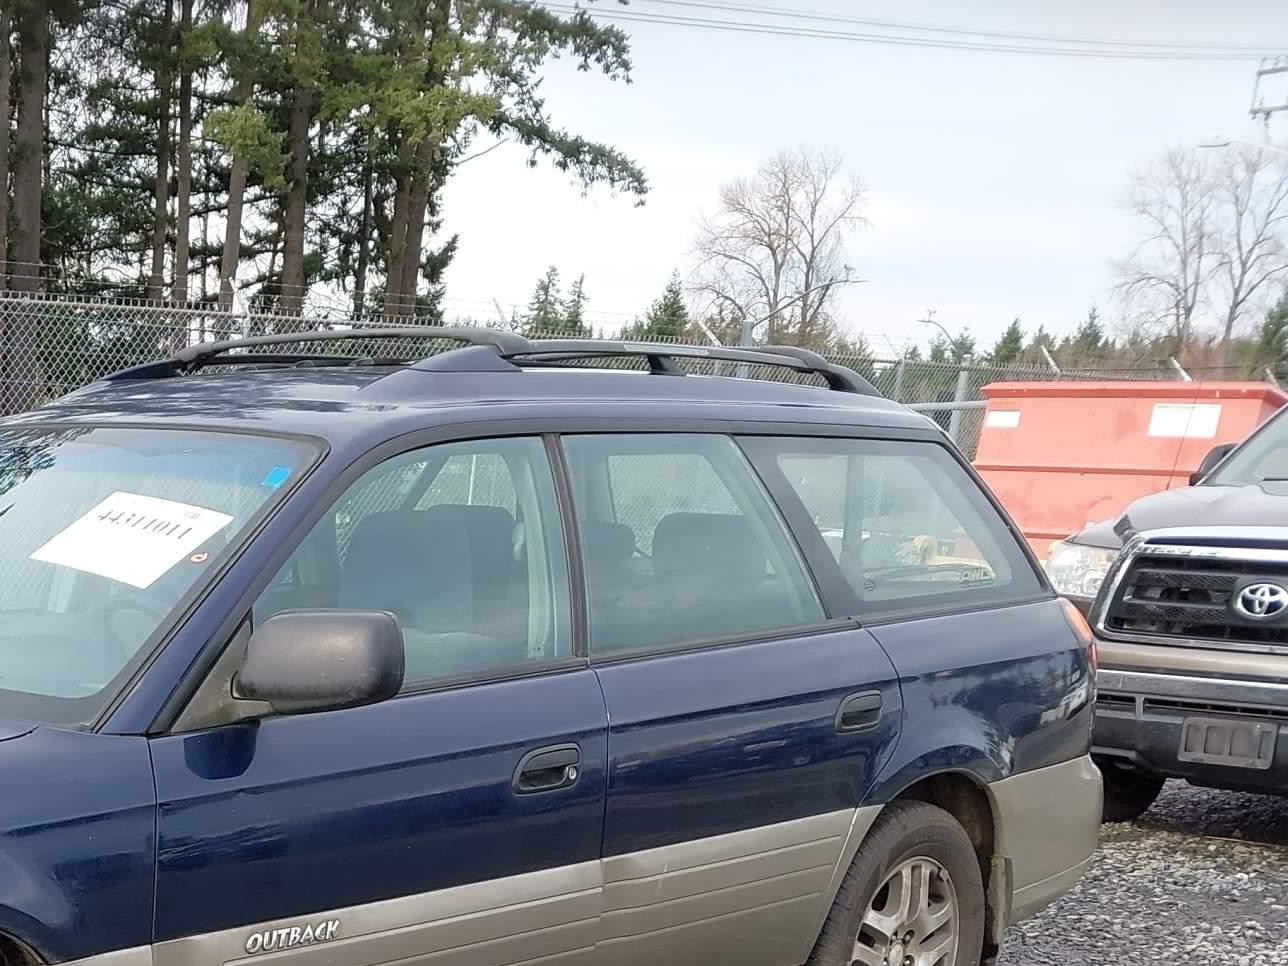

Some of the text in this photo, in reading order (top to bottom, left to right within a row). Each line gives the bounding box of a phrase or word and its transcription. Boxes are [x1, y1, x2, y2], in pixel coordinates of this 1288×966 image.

[97, 509, 193, 539] 44311011
[959, 566, 995, 586] AWD
[245, 919, 340, 954] OUTBACK
